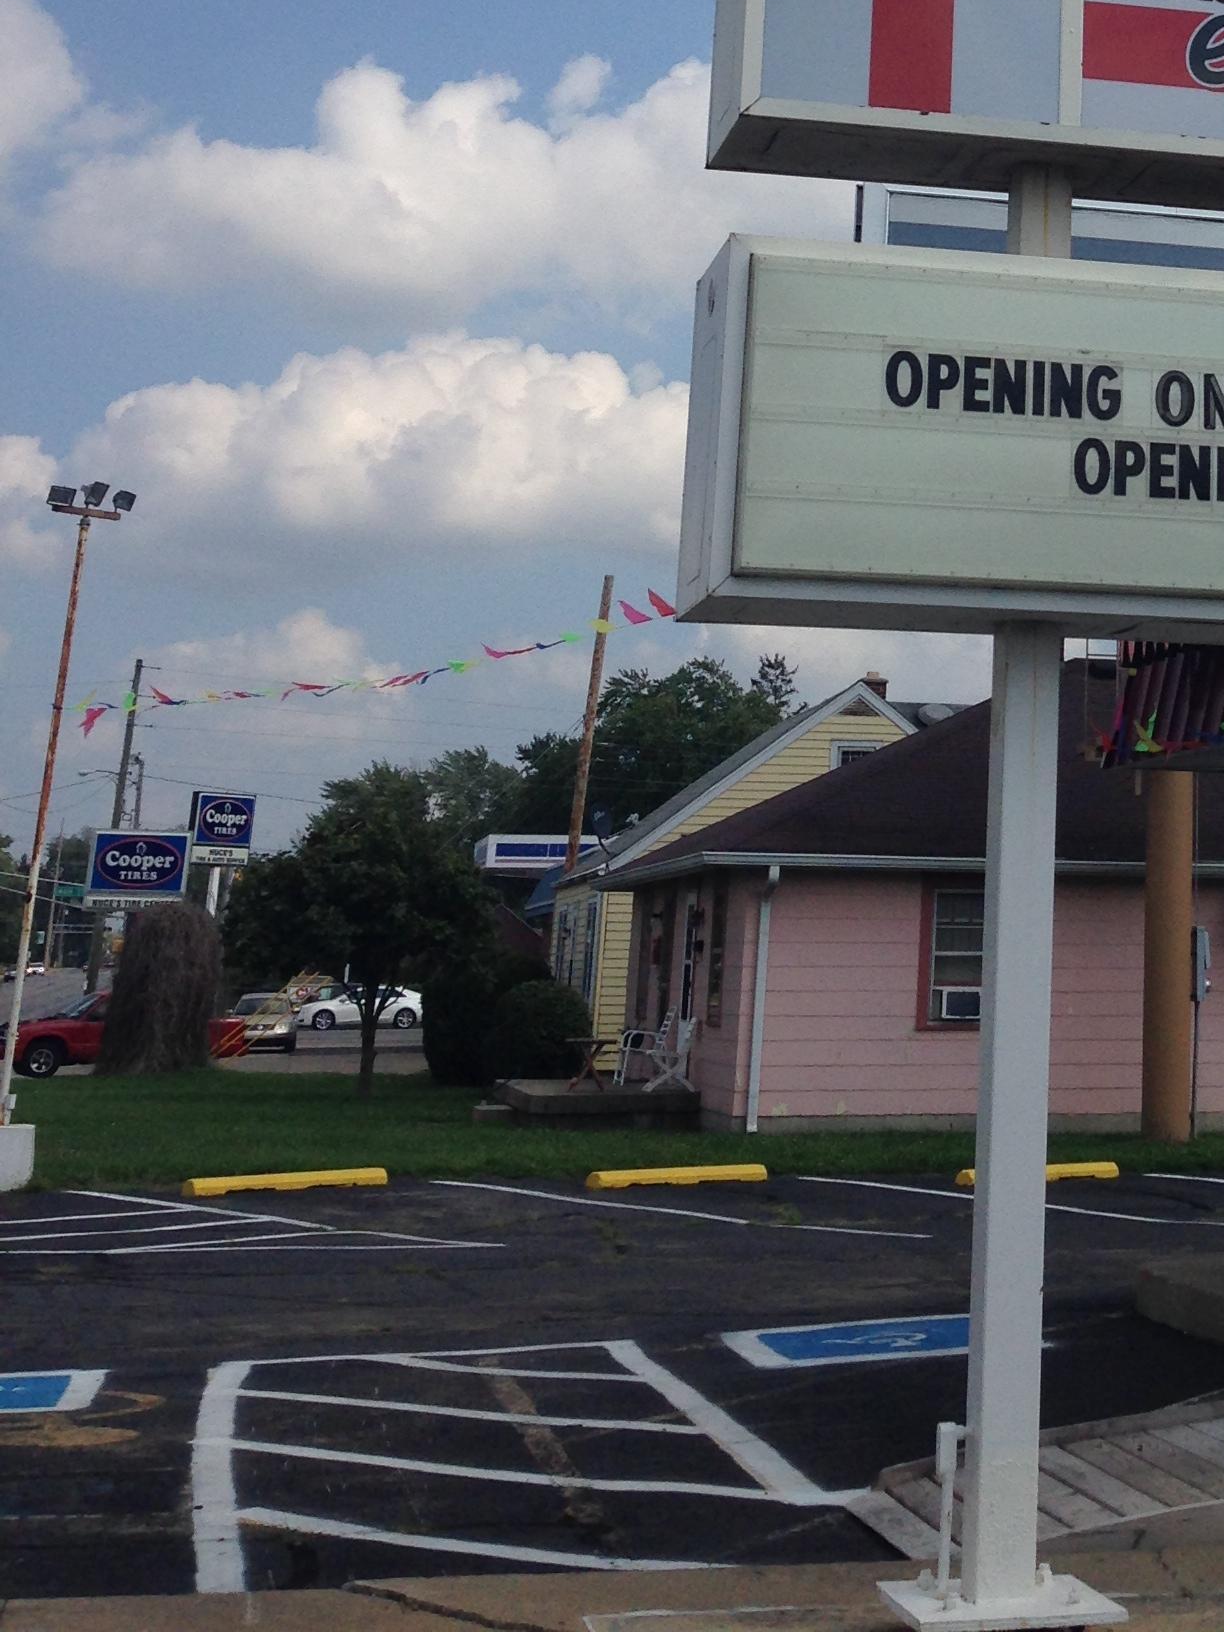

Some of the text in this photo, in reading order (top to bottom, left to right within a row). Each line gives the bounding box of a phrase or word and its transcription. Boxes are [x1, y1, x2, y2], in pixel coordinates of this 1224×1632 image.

[885, 350, 1122, 421] OPENING
[206, 809, 247, 826] Cooper
[214, 827, 237, 835] TIRES
[105, 850, 175, 870] Cooper
[119, 871, 157, 880] TIRES
